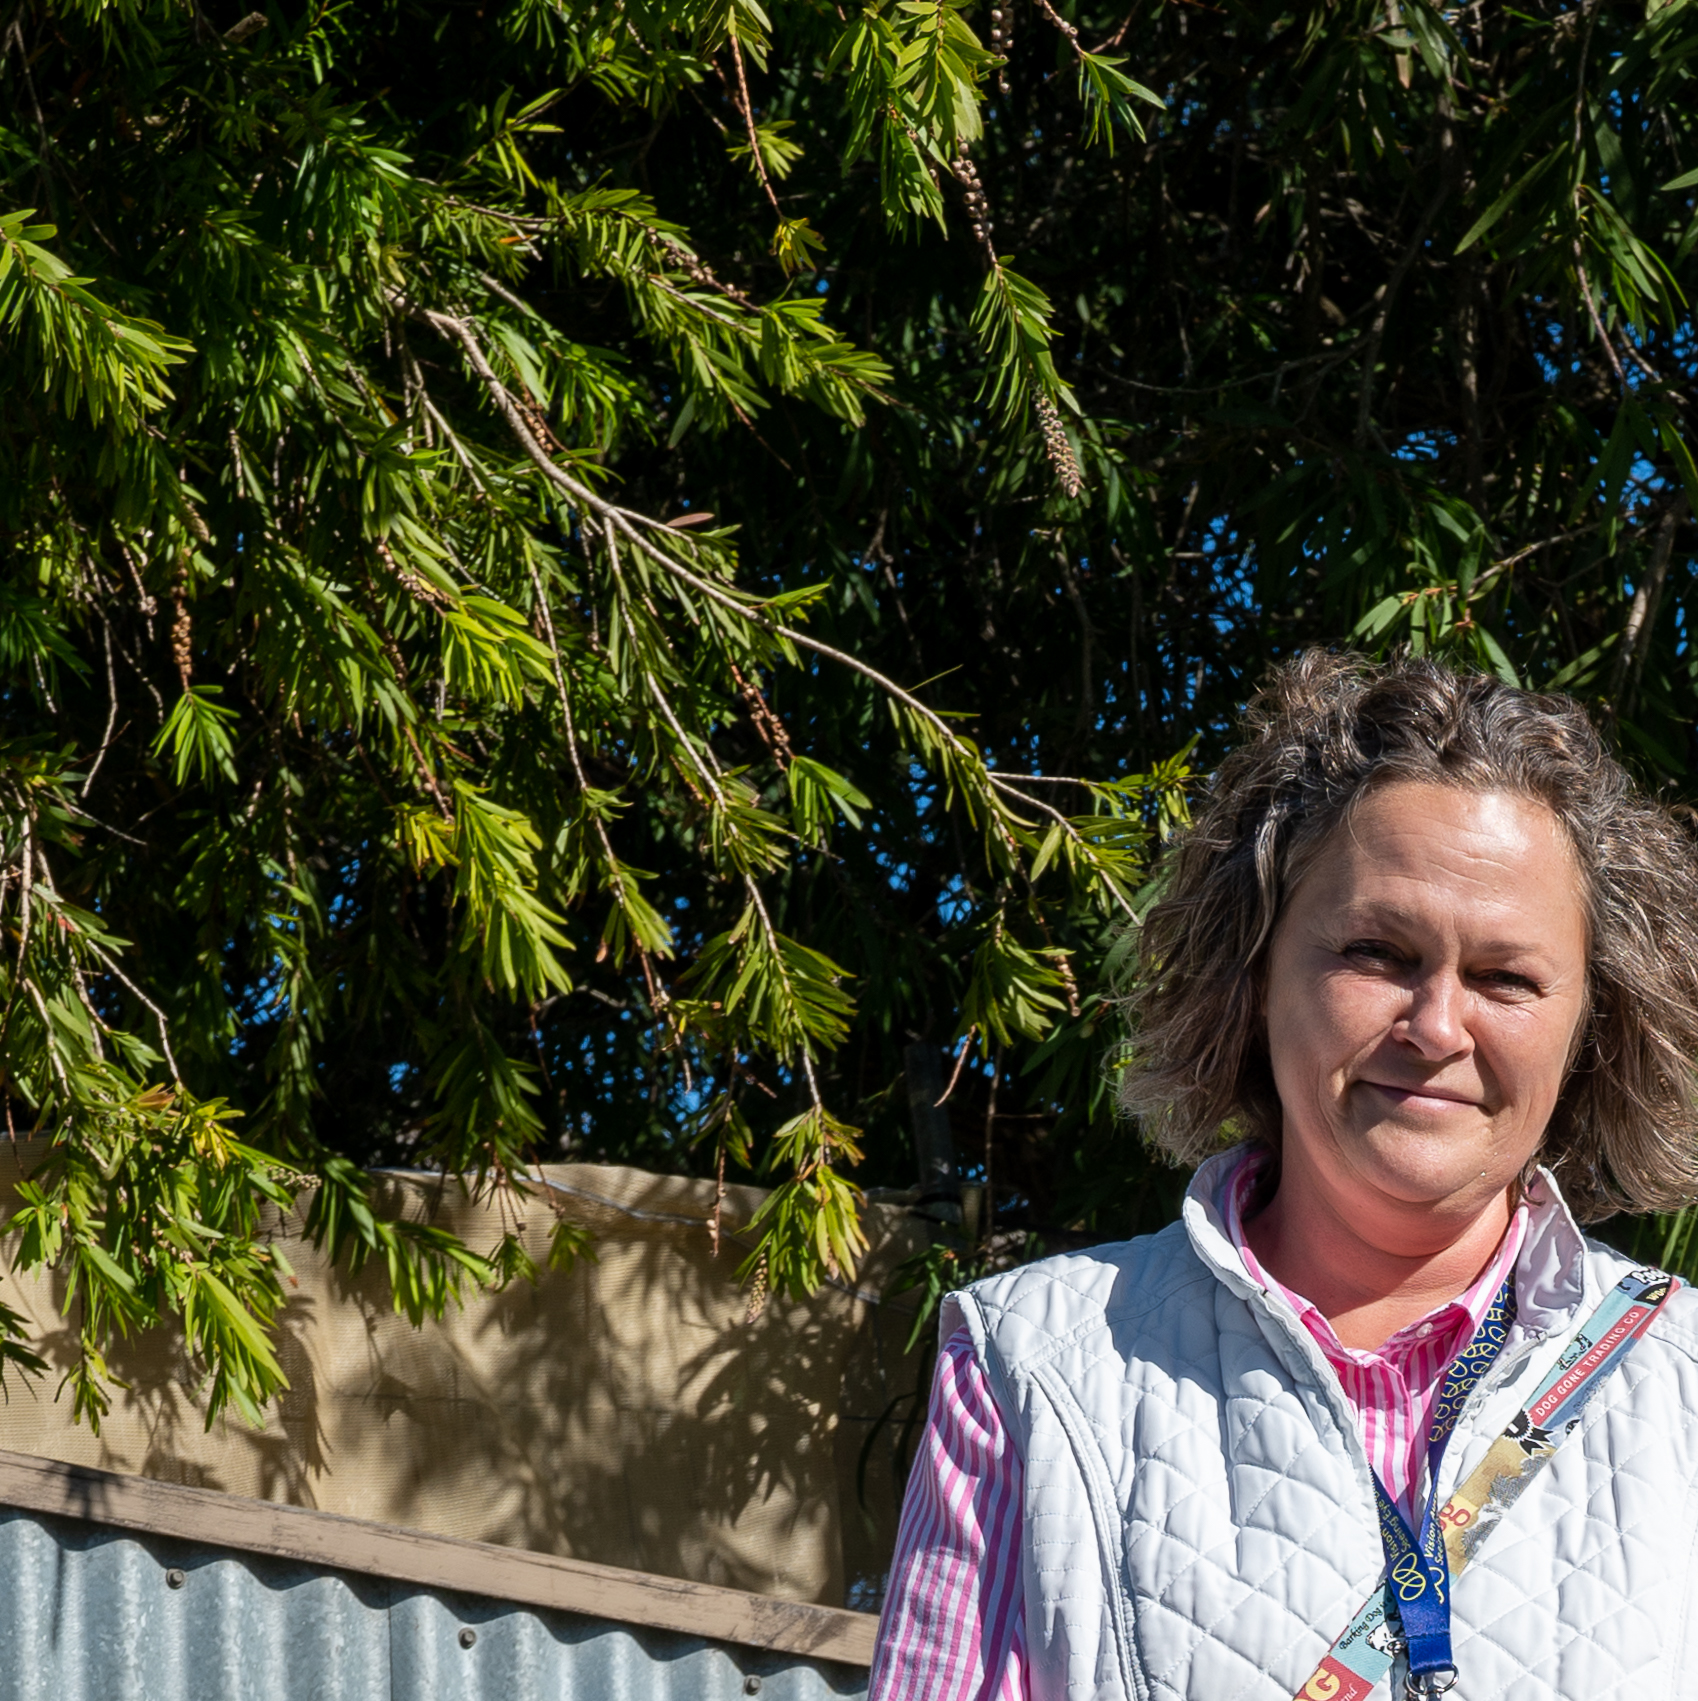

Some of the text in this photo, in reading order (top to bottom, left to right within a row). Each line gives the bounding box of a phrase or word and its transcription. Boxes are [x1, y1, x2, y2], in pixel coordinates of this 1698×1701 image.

[1535, 1311, 1640, 1416] DOG GONE TRADING CO
[1378, 1500, 1412, 1553] Seeing Eye
[1382, 1526, 1400, 1562] Vision
[1424, 1520, 1437, 1559] Vision
[1339, 1621, 1370, 1651] Barking
[1365, 1607, 1383, 1623] Dog
